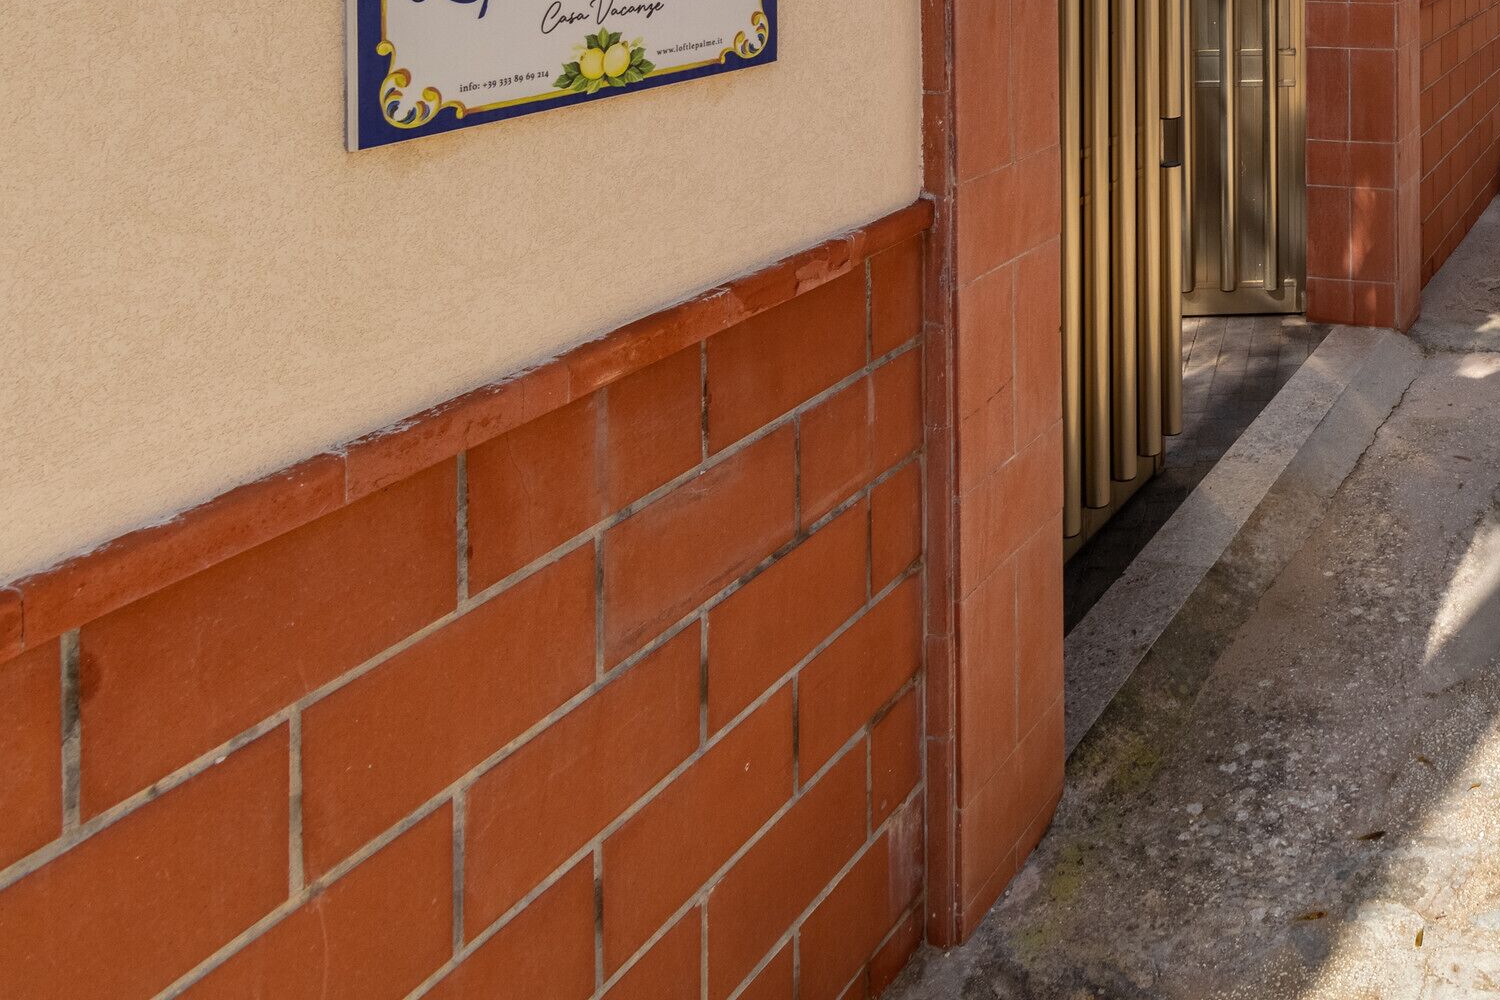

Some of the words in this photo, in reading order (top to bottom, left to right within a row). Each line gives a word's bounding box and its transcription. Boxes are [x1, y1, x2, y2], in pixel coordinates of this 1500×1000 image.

[541, 0, 590, 34] Casa
[656, 37, 723, 55] www.loftlepalme.it
[459, 81, 481, 93] info:
[482, 79, 497, 89] +39
[499, 77, 512, 87] 333
[514, 74, 524, 83] 89
[525, 72, 535, 80] 69
[537, 70, 549, 79] 214
